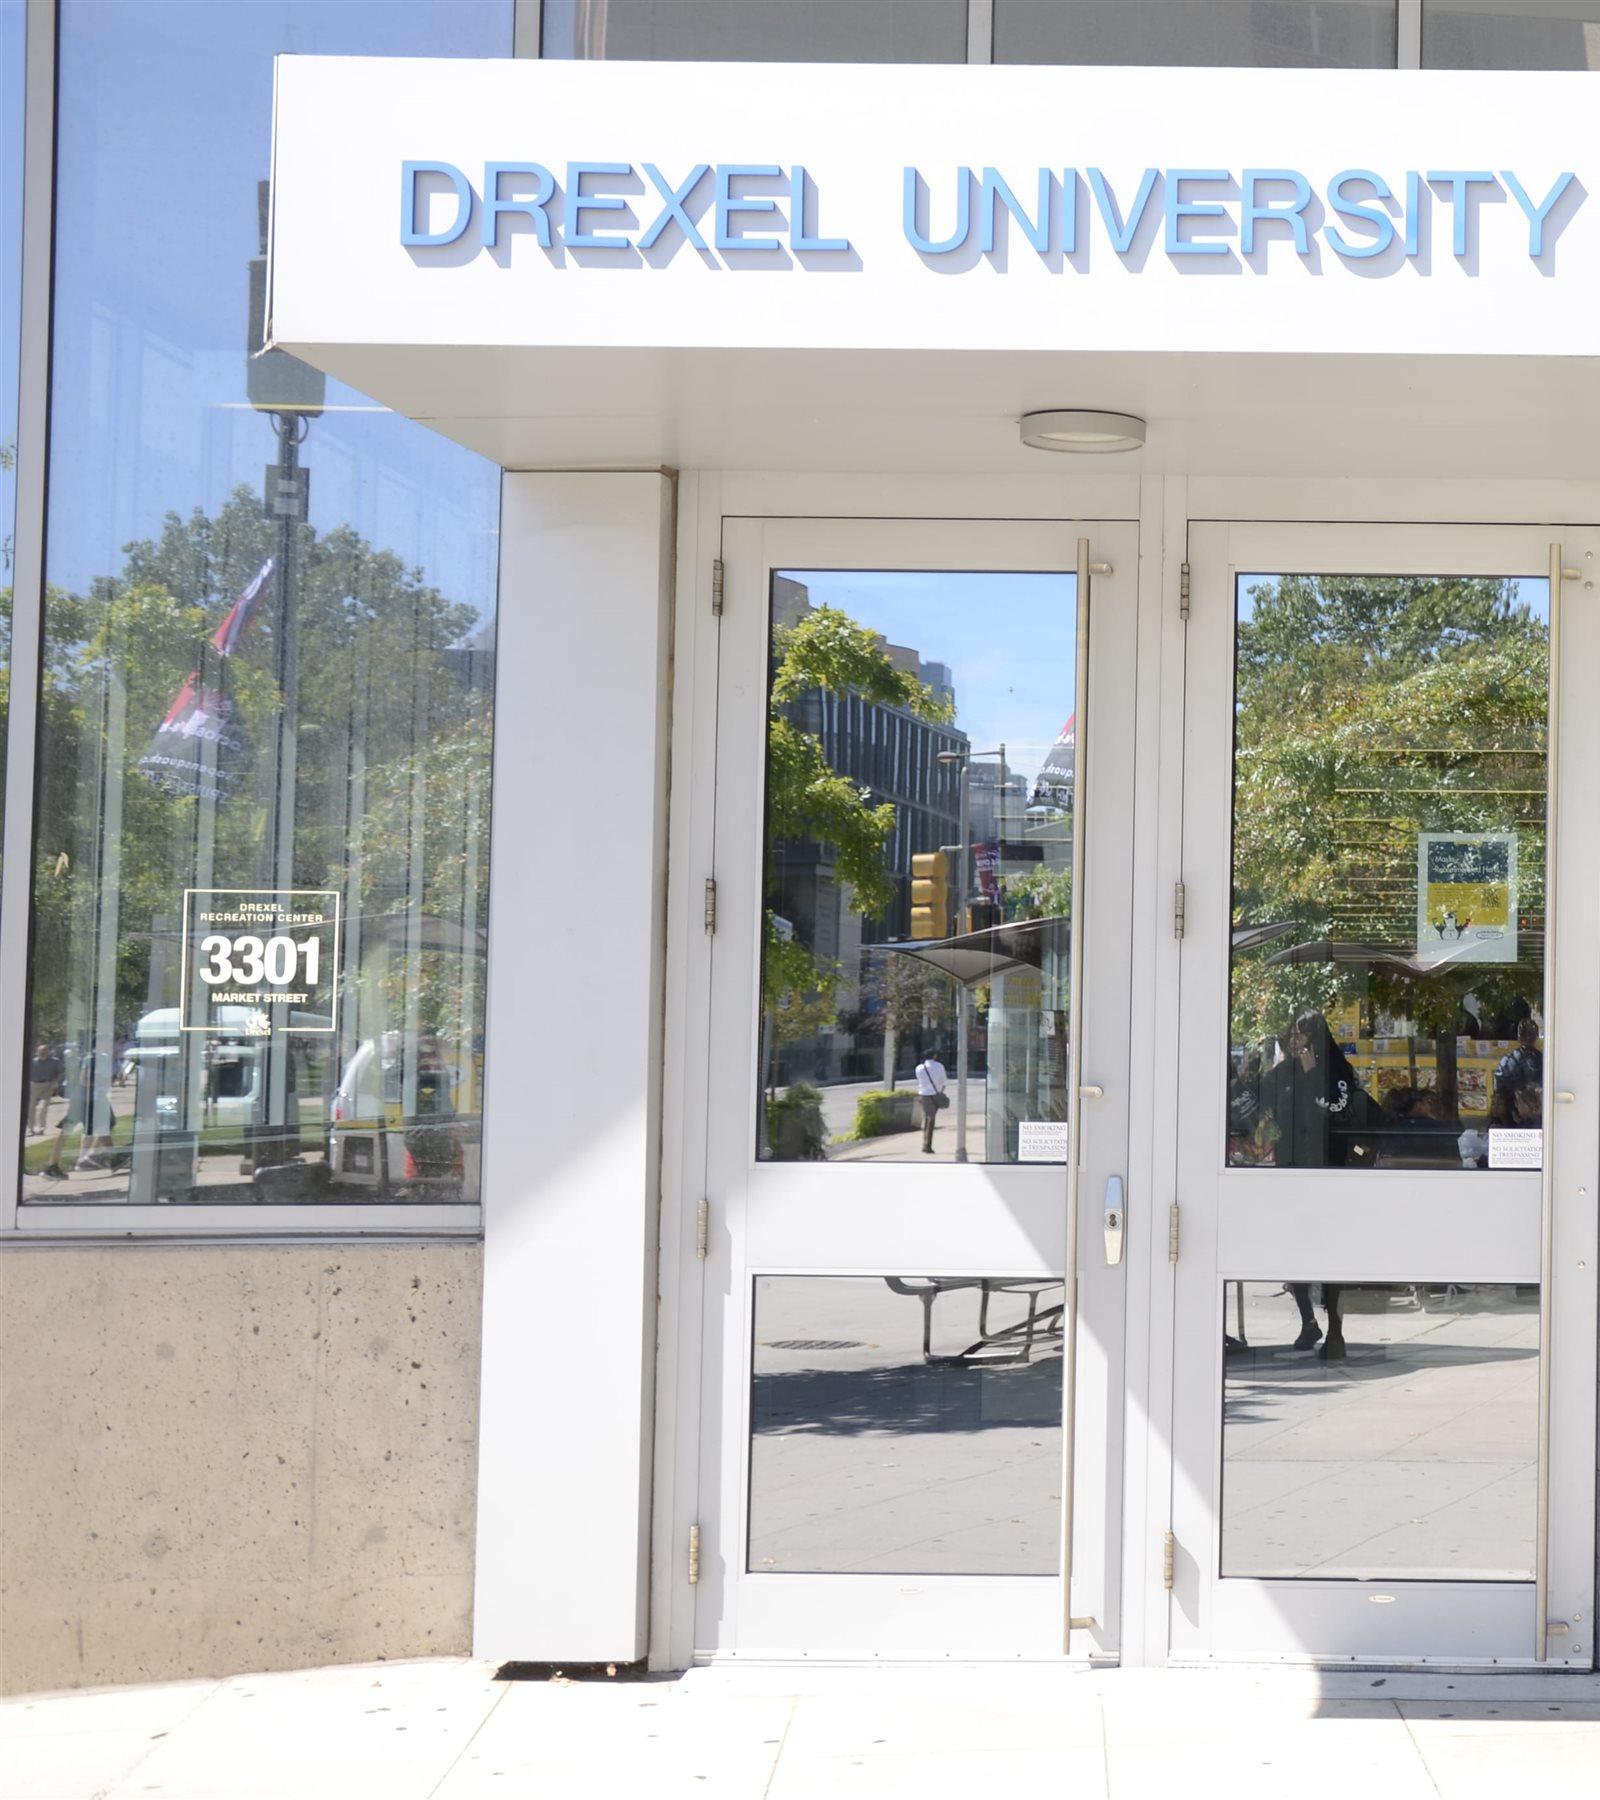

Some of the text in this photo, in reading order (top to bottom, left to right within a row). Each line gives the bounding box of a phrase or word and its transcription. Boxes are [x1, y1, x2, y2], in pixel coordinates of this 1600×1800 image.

[399, 159, 850, 251] DREXEL
[902, 166, 1576, 258] UNIVERSITY
[239, 903, 285, 912] DREXEL
[200, 913, 323, 923] RECREATION CENTER
[199, 935, 320, 985] 3301
[211, 992, 309, 1003] MARKET STREET
